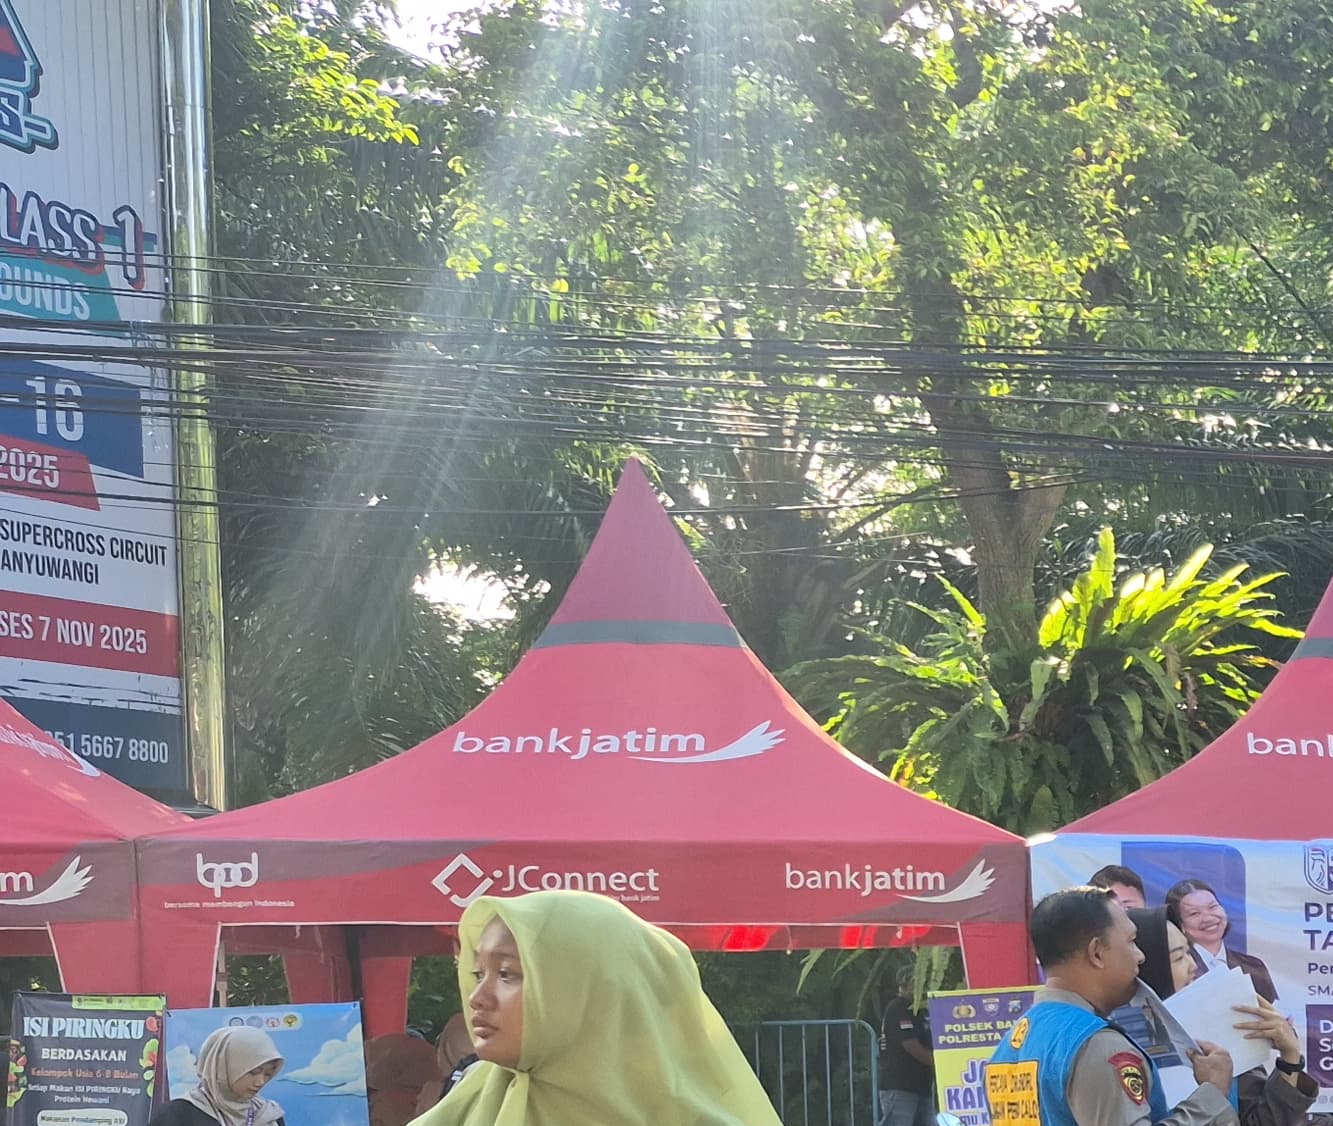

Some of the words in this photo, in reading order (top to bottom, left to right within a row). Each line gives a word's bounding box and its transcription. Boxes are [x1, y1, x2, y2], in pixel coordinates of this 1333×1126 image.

[26, 376, 84, 441] 16
[0, 518, 105, 556] SUPERCROSS
[110, 537, 167, 566] CIRCUIT
[0, 550, 99, 584] ANYUWANGI
[38, 616, 50, 641] 7
[57, 618, 94, 647] NOV
[100, 624, 147, 654] 2025
[81, 735, 124, 759] 5667
[129, 739, 168, 763] 8800
[452, 728, 706, 760] bankjatim
[501, 864, 660, 891] JConnect
[785, 862, 946, 897] bankjatim
[23, 1016, 49, 1037] ISI
[52, 1017, 145, 1039] PIRINGKU
[938, 1033, 1002, 1044] POLRESTA
[944, 1022, 993, 1033] POLSEK
[41, 1048, 127, 1061] BERDASAKAN
